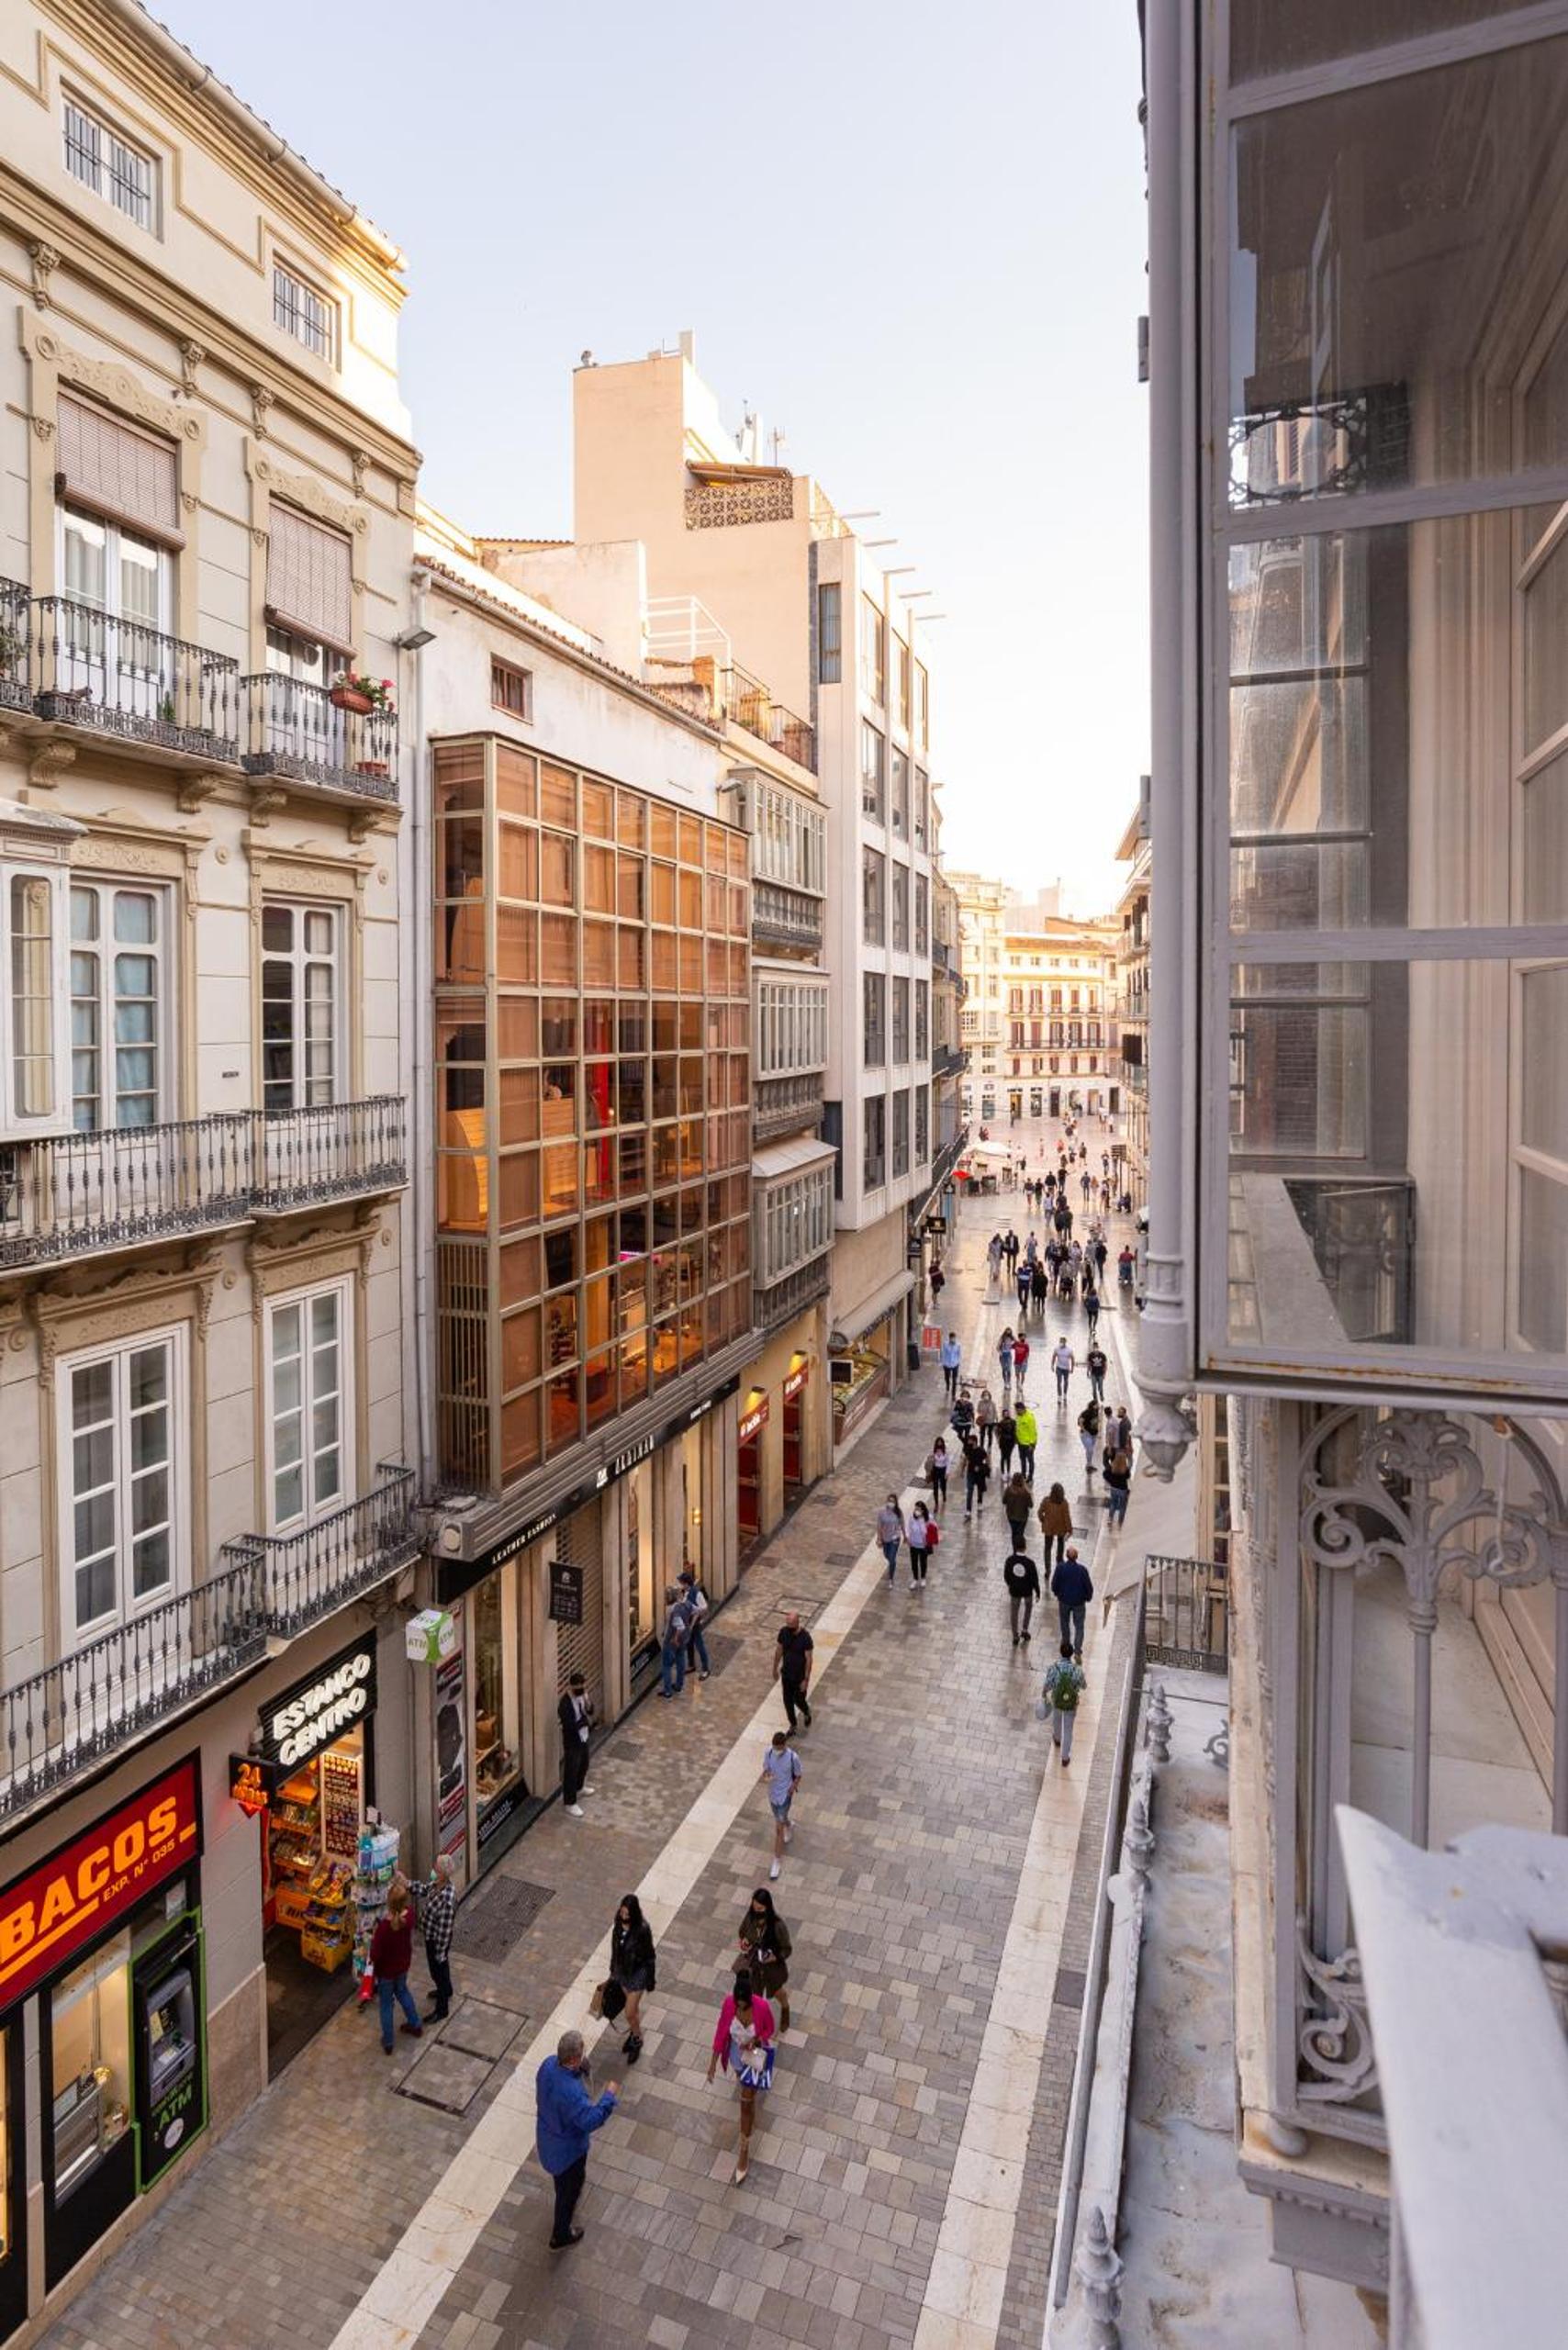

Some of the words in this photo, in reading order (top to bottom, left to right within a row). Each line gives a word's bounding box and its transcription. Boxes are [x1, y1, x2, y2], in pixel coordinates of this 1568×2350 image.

[492, 1534, 526, 1564] LEATHER
[408, 1638, 427, 1649] ATM
[273, 1653, 371, 1740] ESTANCO
[279, 1687, 367, 1766] CENTRO
[238, 1762, 262, 1787] 24
[0, 1796, 177, 1964] BACOS
[103, 1877, 129, 1902] EXP.
[152, 1839, 174, 1863] 035
[159, 2085, 192, 2131] ATM
